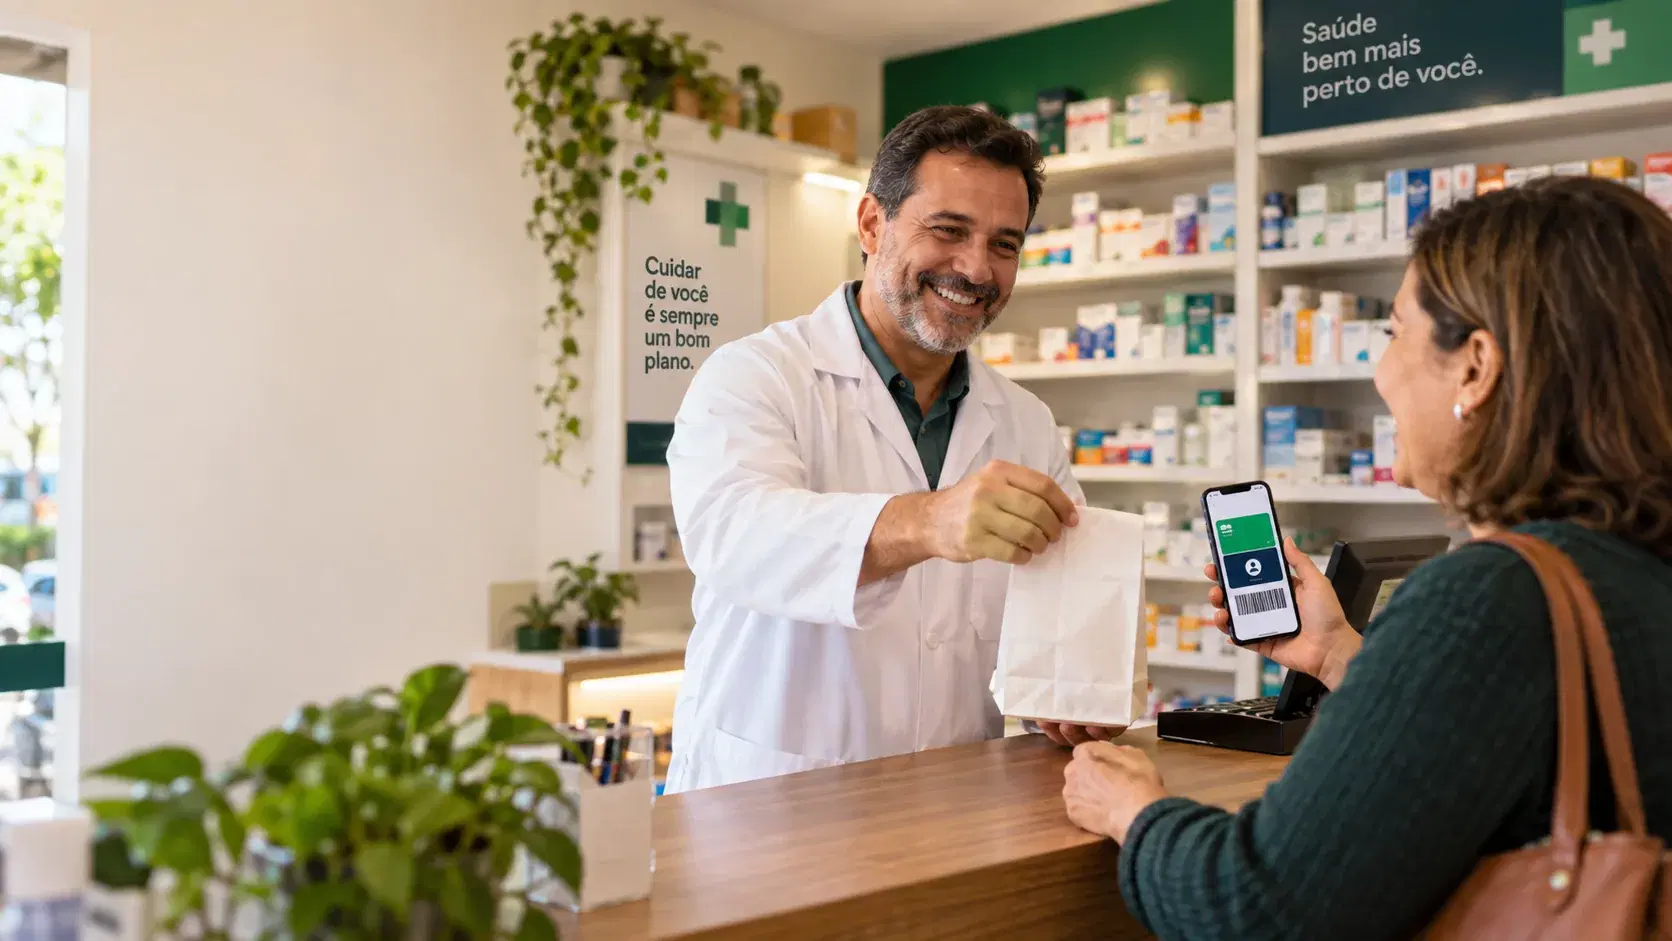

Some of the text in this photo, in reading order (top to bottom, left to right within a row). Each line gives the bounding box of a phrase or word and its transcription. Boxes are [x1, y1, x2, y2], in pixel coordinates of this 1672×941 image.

[1302, 13, 1377, 44] Saúde
[1303, 34, 1422, 74] bem mais
[1303, 53, 1484, 108] perto de você.
[645, 256, 702, 279] Cuidar
[645, 280, 708, 302] de você
[645, 303, 719, 330] é sempre
[645, 329, 710, 348] um bom
[645, 351, 694, 374] plano.
